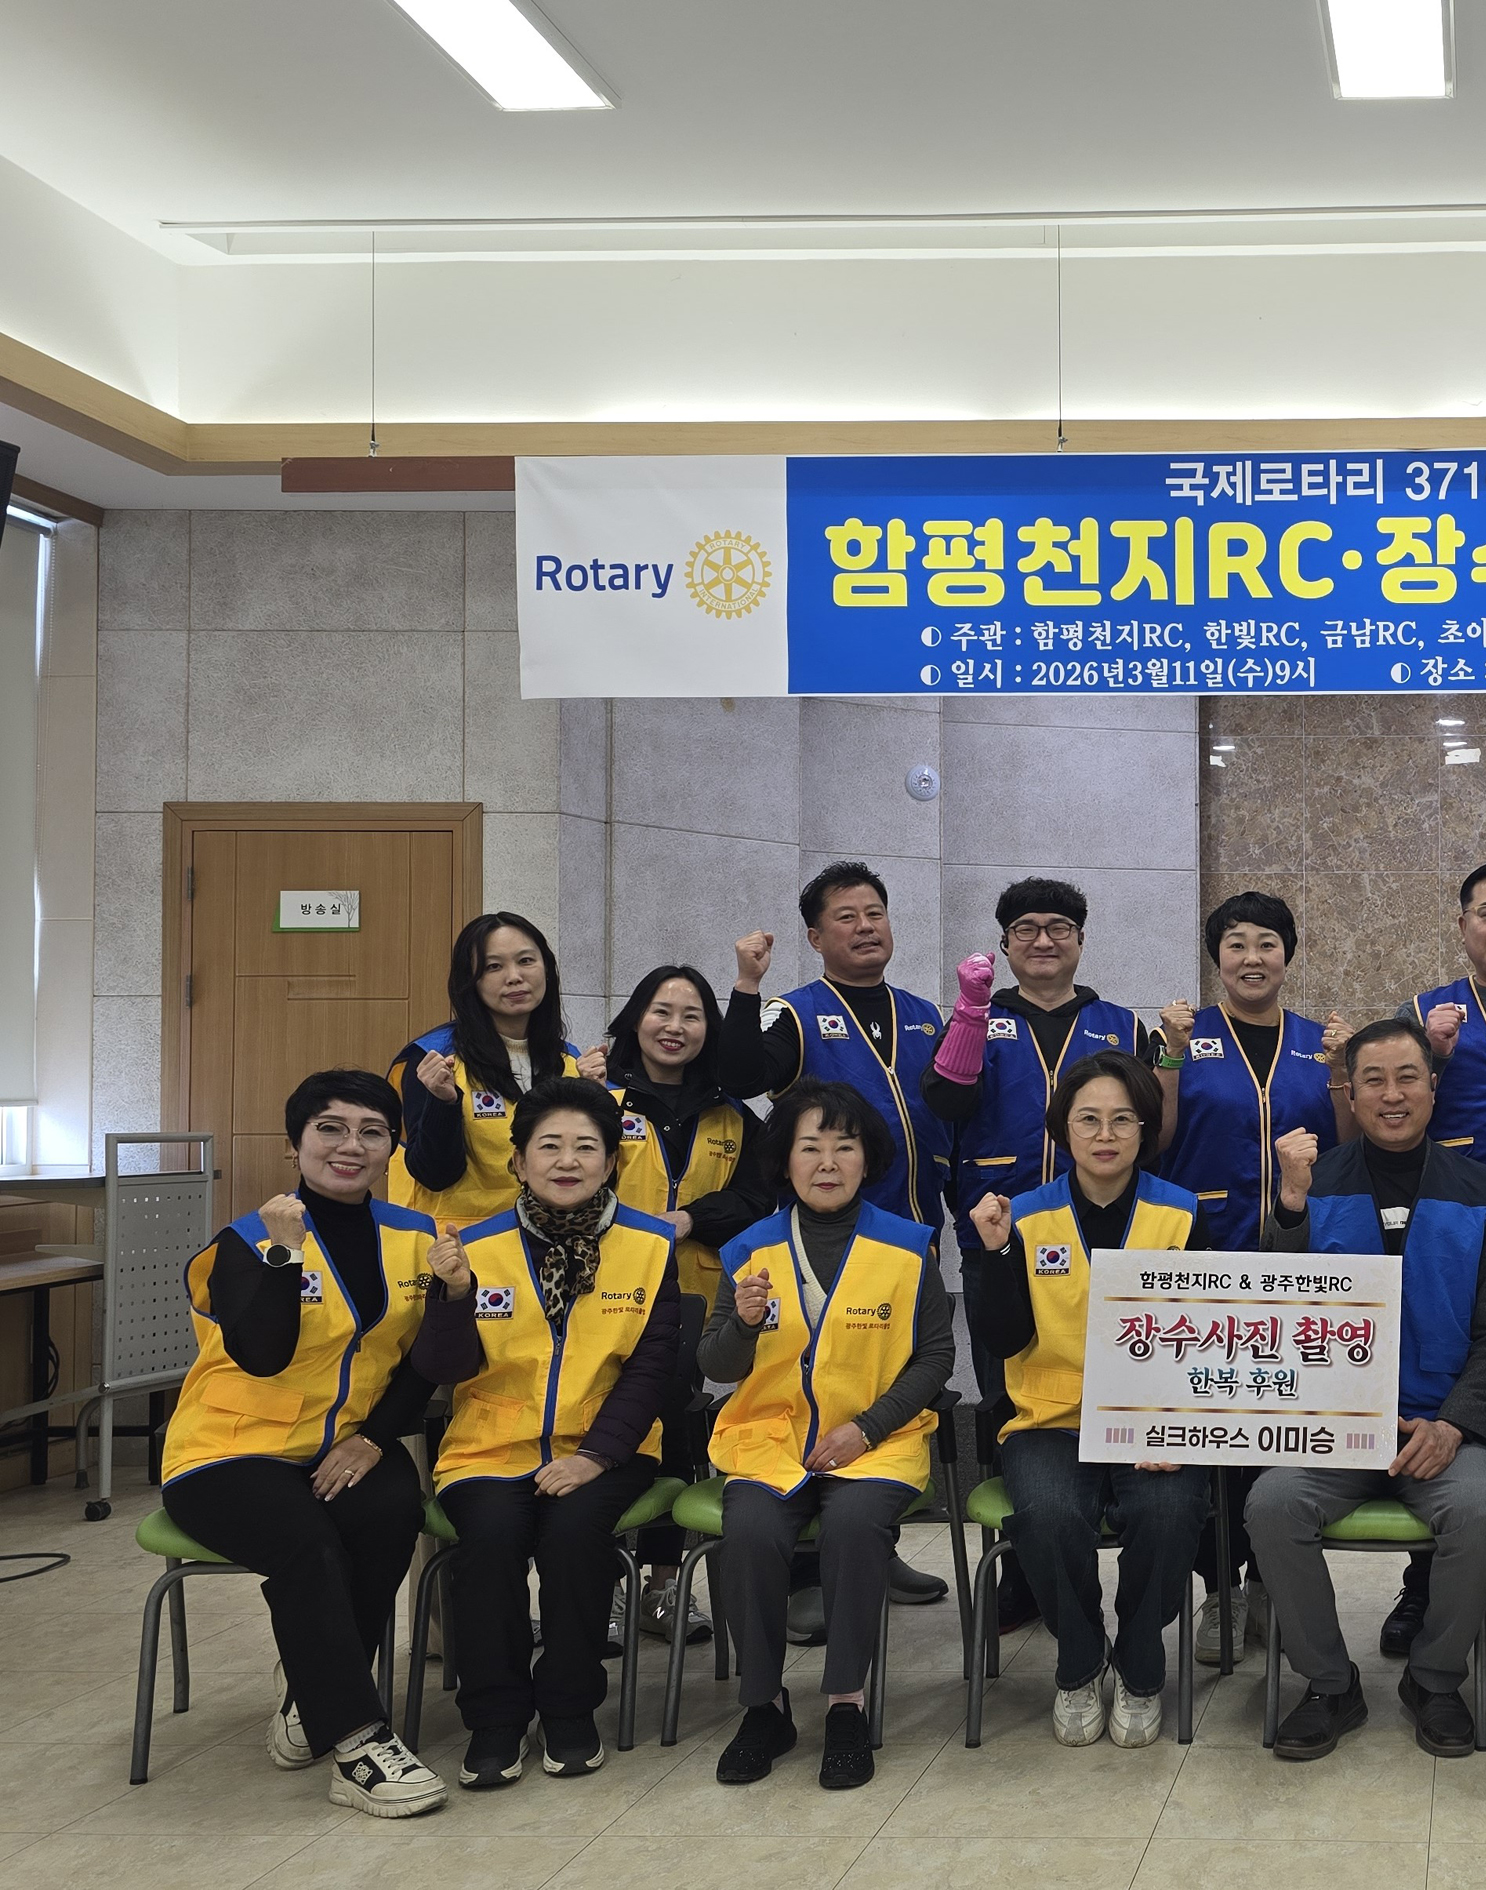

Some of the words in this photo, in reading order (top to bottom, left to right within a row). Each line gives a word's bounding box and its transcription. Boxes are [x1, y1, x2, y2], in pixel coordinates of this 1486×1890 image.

[1165, 458, 1384, 505] 국제로타리
[708, 540, 746, 550] ROTARY
[536, 555, 674, 598] Rotary
[699, 587, 759, 610] INTERNATIONAL
[951, 622, 1006, 650] 주관
[1031, 620, 1191, 651] 함평천지RC,
[1203, 620, 1308, 651] 한빛RC,
[1319, 618, 1425, 650] 금남RC,
[951, 658, 1003, 688] 일시
[1031, 657, 1316, 688] 2026년3월11일(수)9시
[1420, 657, 1477, 685] 장소
[601, 1291, 632, 1300] Rotary
[1139, 1271, 1232, 1291] 함평천지RC
[1238, 1275, 1252, 1290] &
[1259, 1273, 1353, 1293] 광주한빛RC
[846, 1306, 877, 1317] Rotary
[1115, 1313, 1282, 1362] 장수사진
[1292, 1315, 1376, 1365] 촬영
[1187, 1366, 1240, 1398] 한복
[1246, 1367, 1299, 1400] 후원
[1145, 1425, 1250, 1449] 실크하우스
[1258, 1425, 1335, 1454] 이미승
